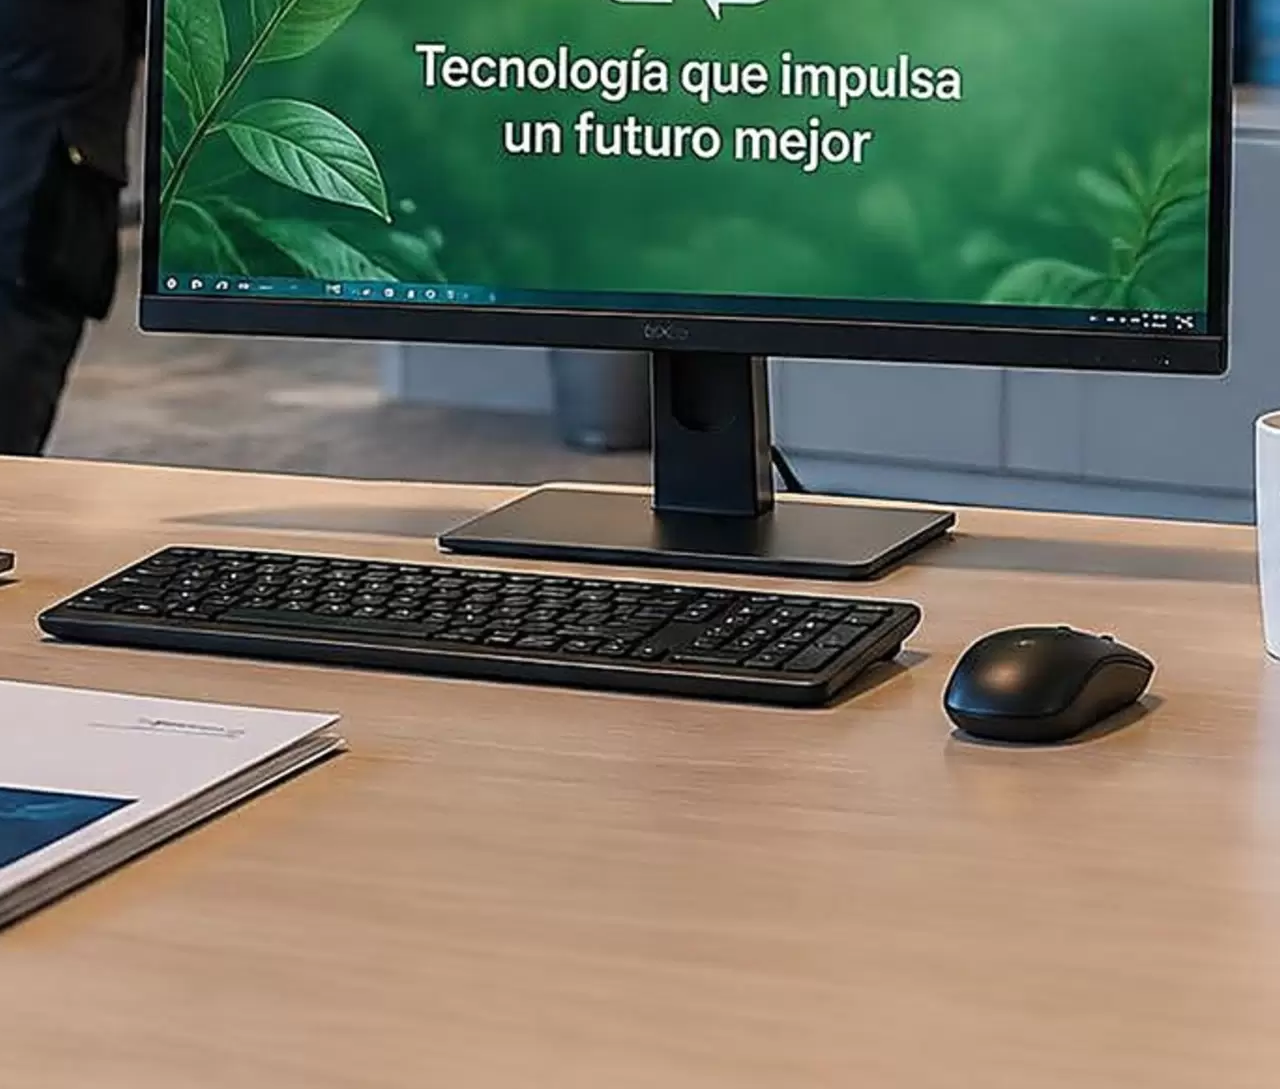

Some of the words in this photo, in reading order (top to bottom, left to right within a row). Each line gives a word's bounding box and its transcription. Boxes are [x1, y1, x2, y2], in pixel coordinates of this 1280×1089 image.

[415, 44, 668, 101] Tecnología
[682, 61, 768, 103] que
[781, 52, 961, 108] impulsa
[505, 122, 561, 153] un
[574, 110, 721, 158] futuro
[735, 117, 871, 172] mejor
